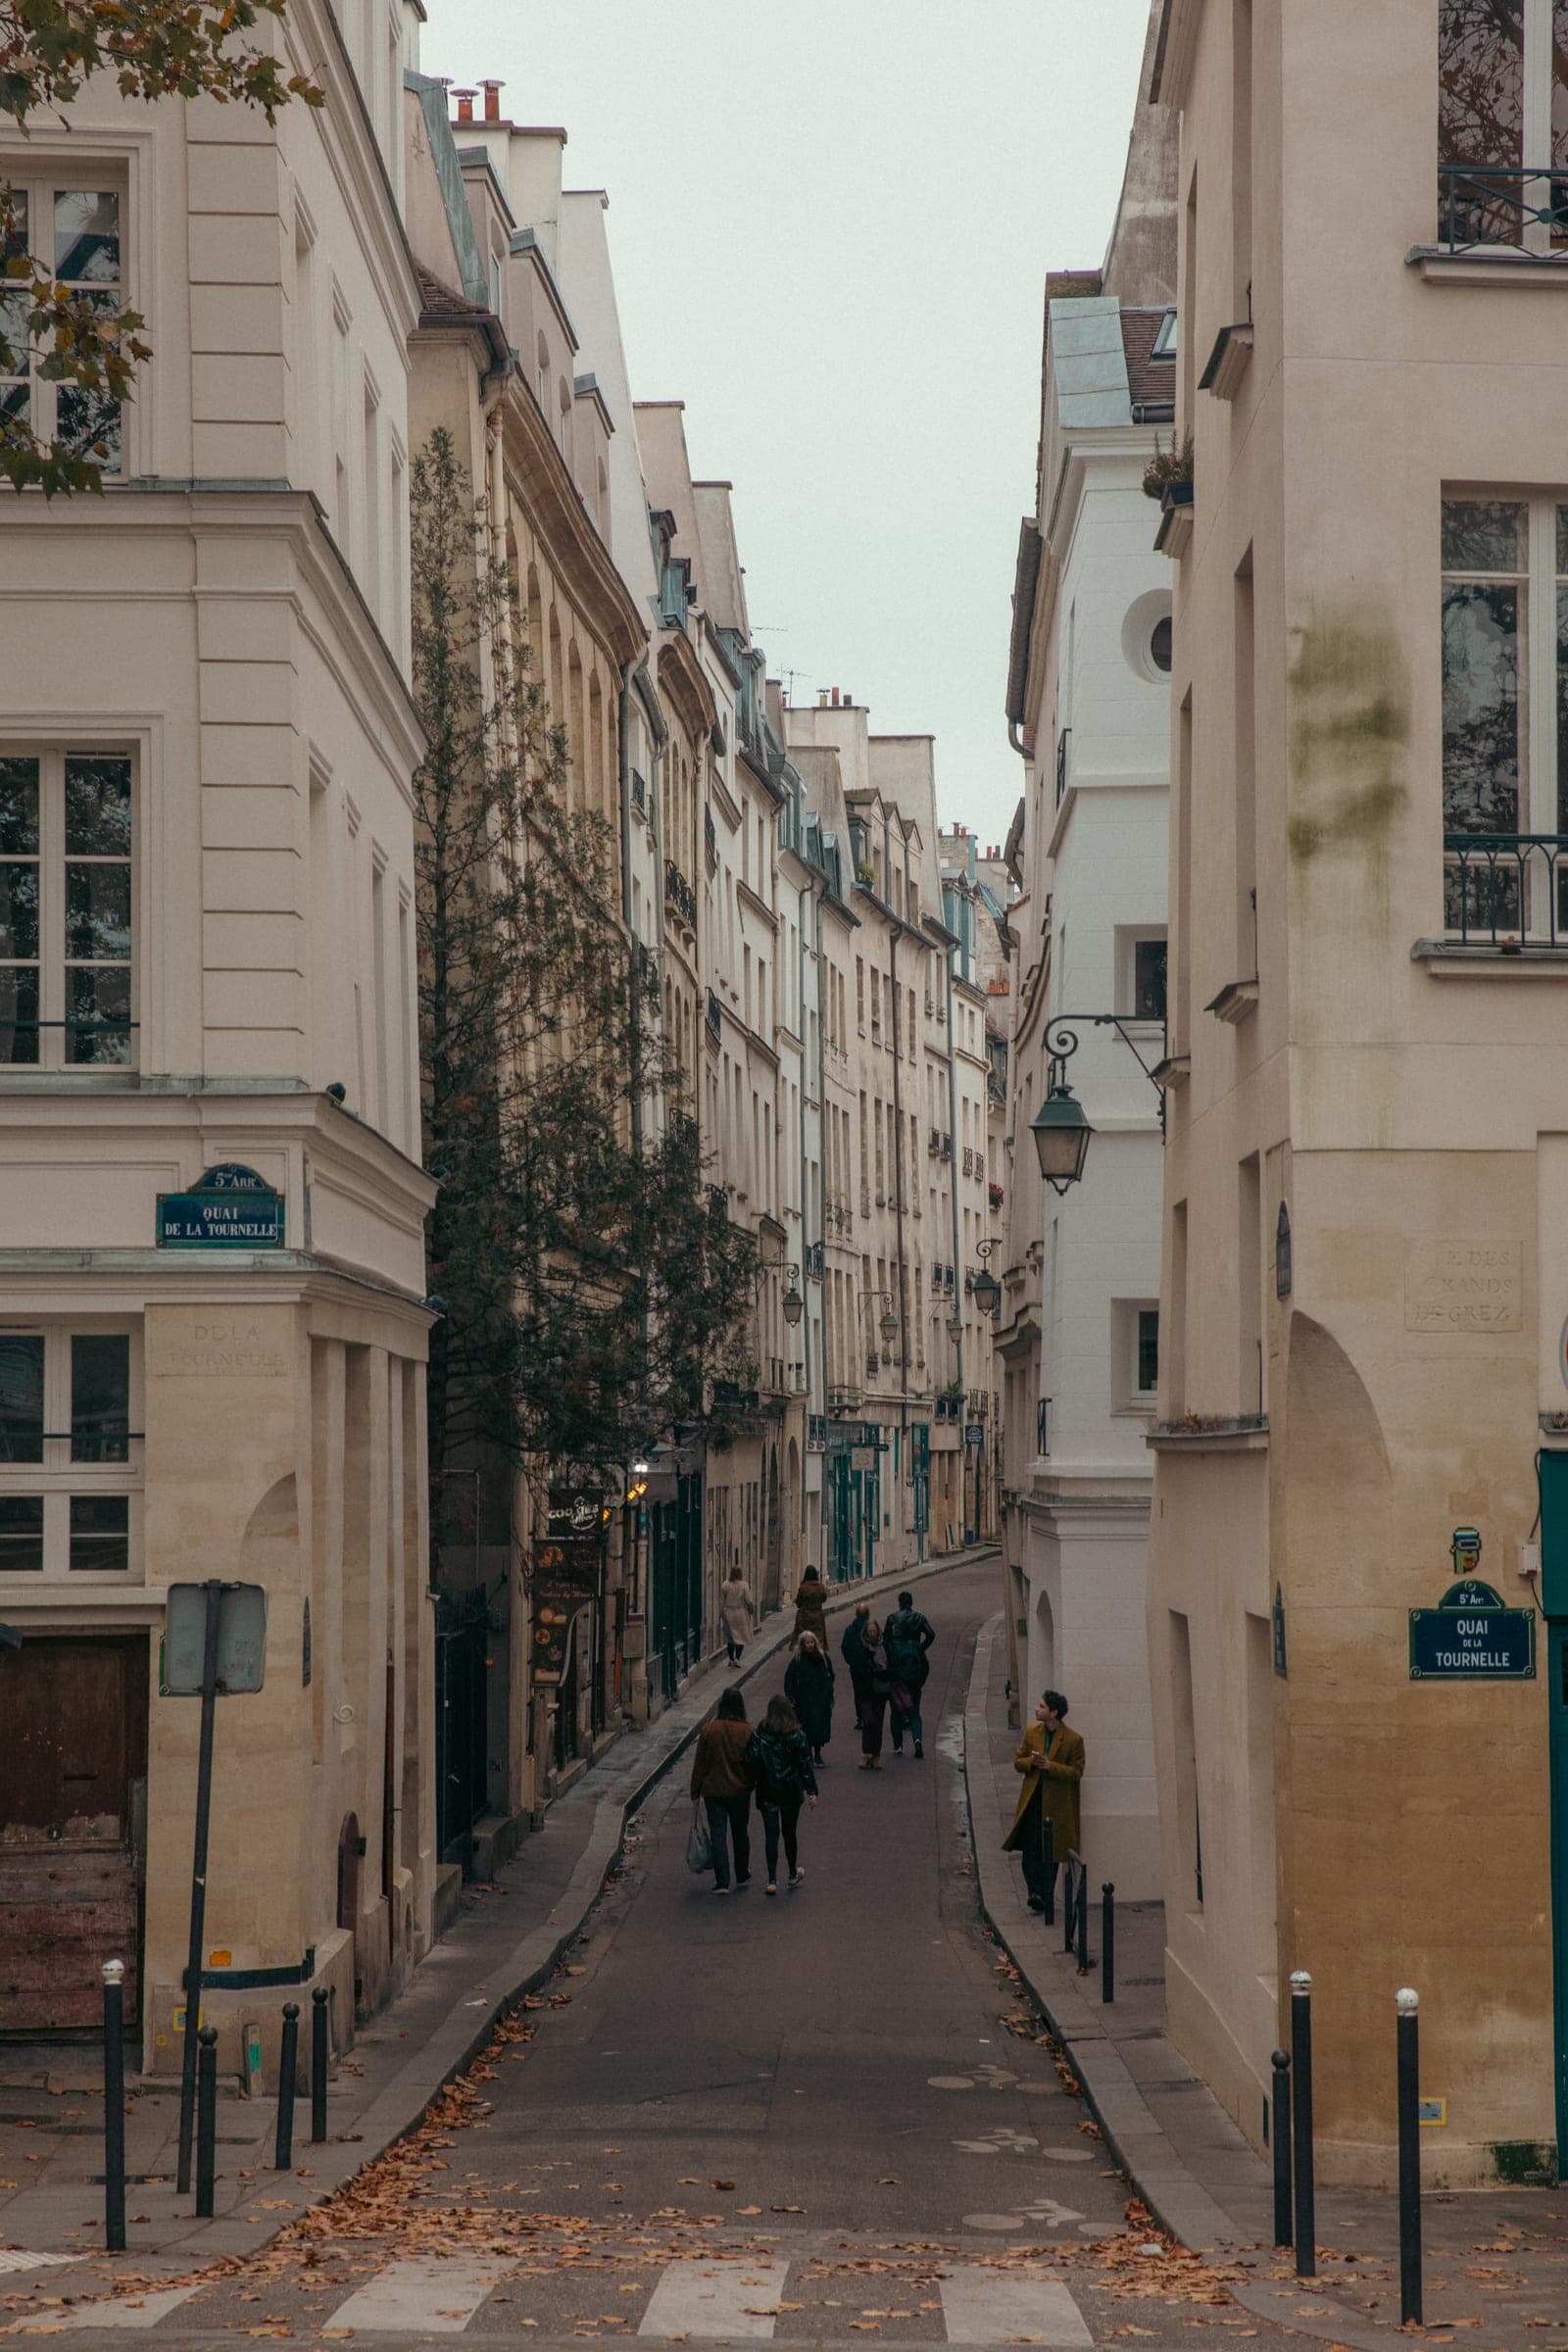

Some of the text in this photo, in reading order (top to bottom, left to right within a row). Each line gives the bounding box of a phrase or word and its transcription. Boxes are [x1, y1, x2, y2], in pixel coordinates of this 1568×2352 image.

[203, 1207, 238, 1222] QUAI
[165, 1223, 276, 1236] DE LA TOURNELLE
[1456, 1620, 1489, 1636] QUAI
[1462, 1639, 1483, 1648] DE LA
[1436, 1652, 1510, 1667] TOURNELLE
